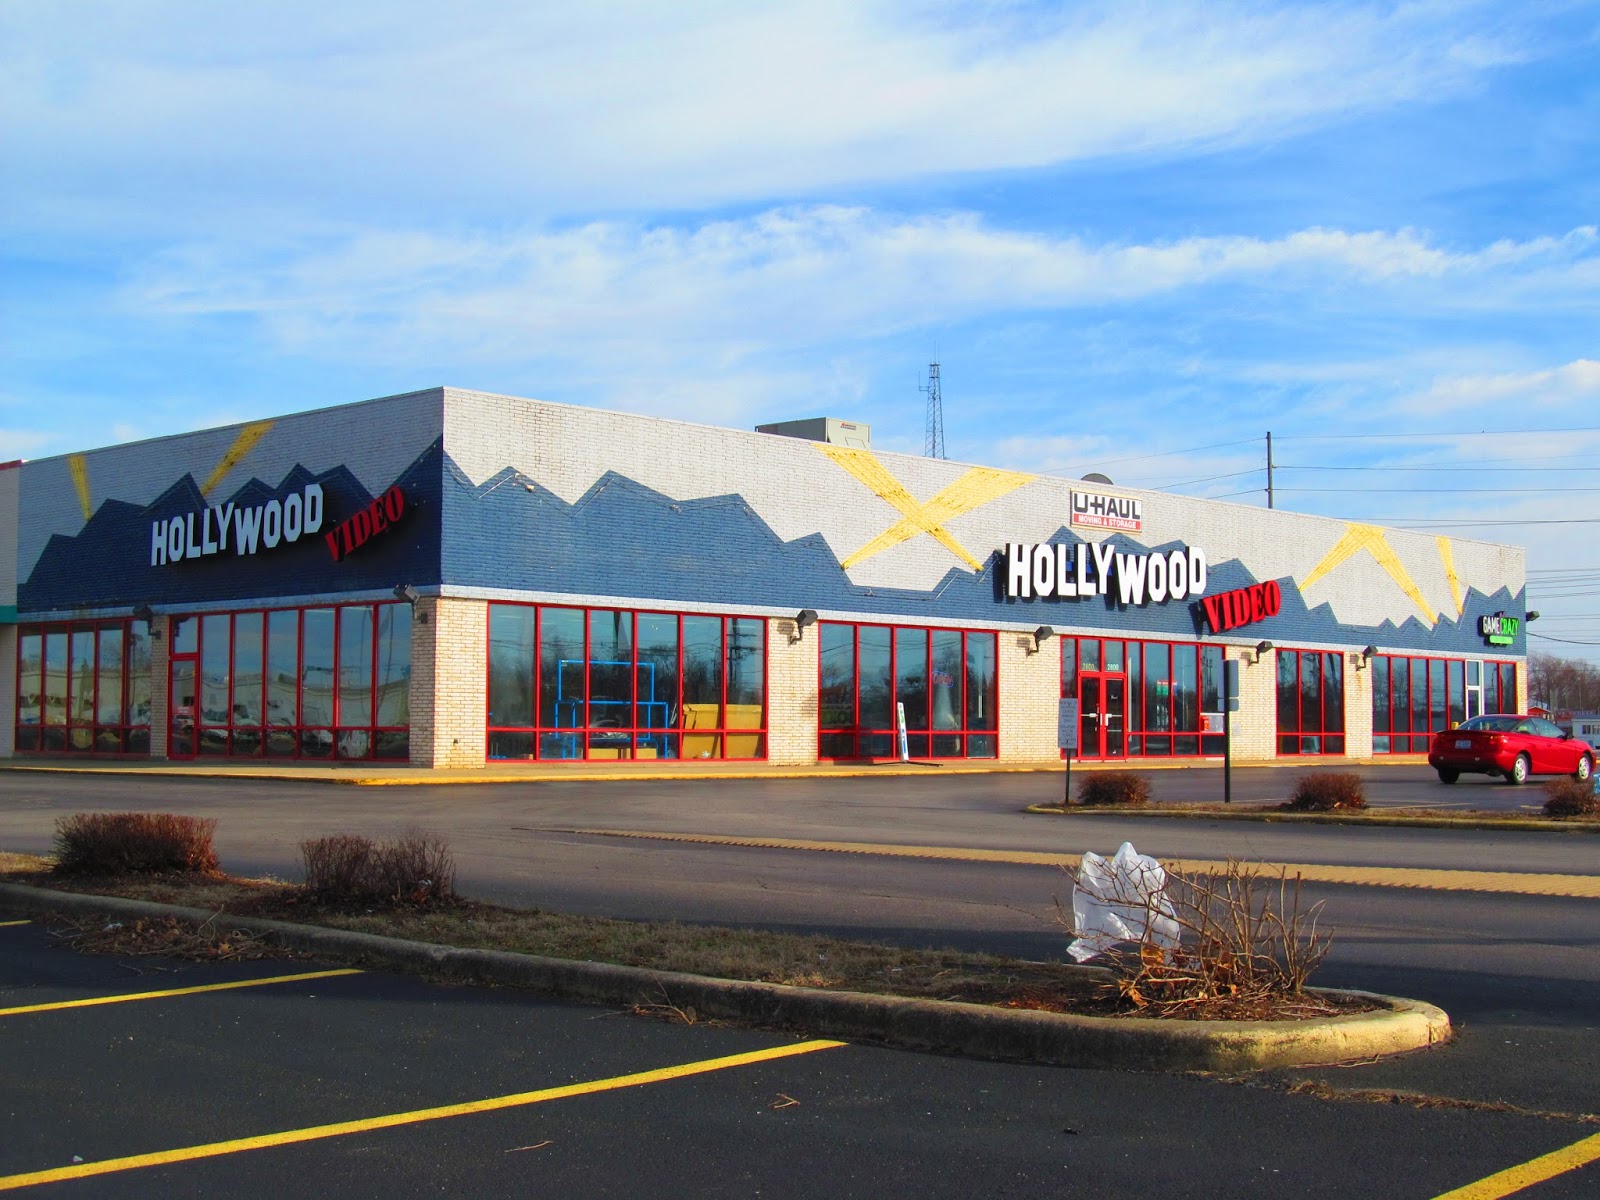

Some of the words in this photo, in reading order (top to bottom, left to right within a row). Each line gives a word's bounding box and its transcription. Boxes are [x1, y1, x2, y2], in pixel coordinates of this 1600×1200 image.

[151, 483, 324, 567] HOLLYWOOD
[324, 485, 405, 562] VIDEO
[1078, 515, 1102, 525] MOVING
[1108, 518, 1137, 529] STORAGE
[1007, 542, 1207, 605] HOLLYWOOD
[1203, 580, 1281, 634] VIDEO
[1482, 616, 1500, 634] GAME
[1500, 617, 1519, 636] CRAZY
